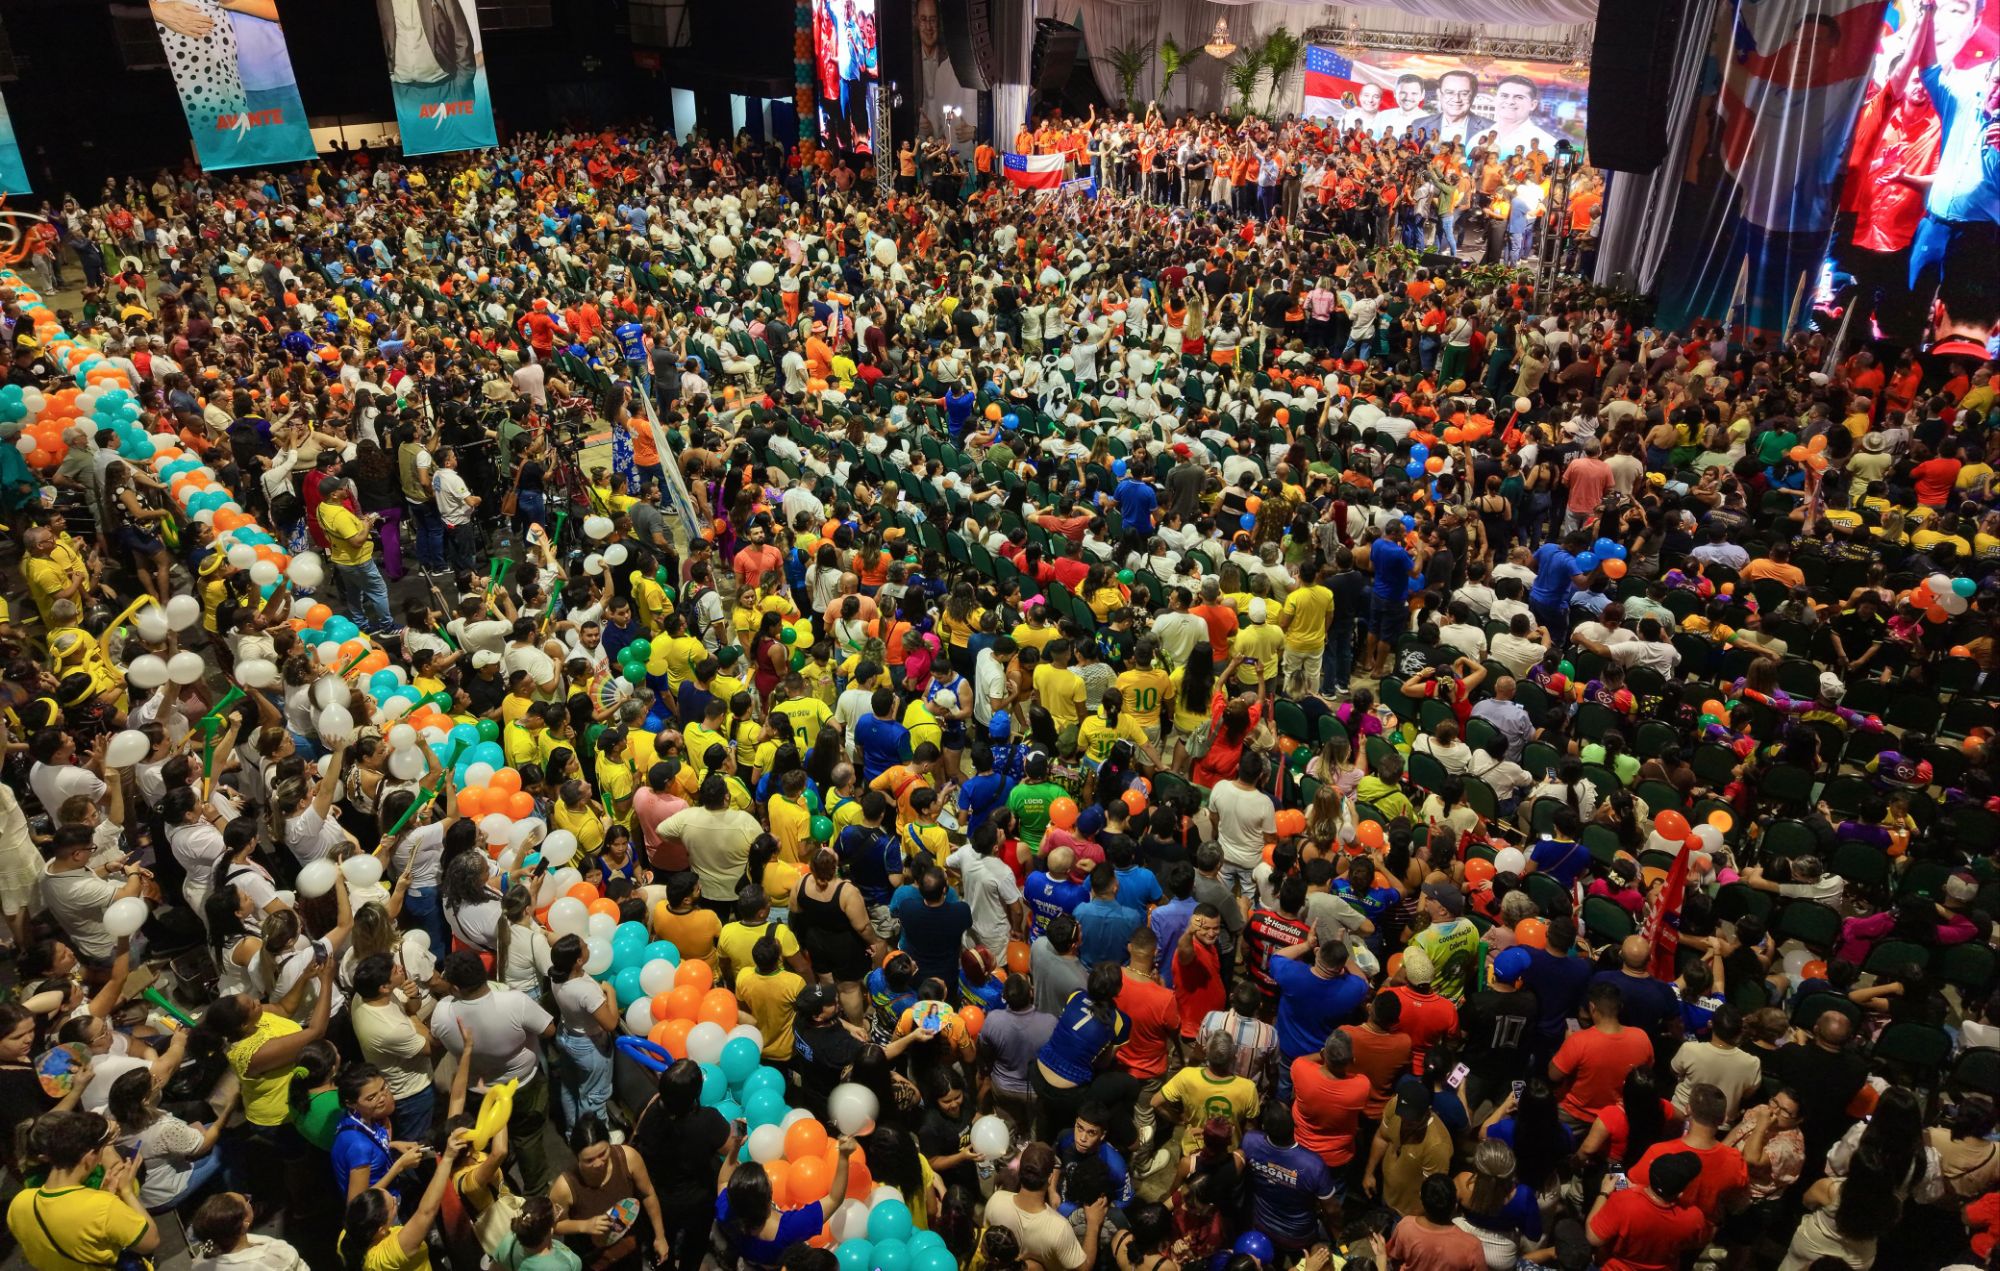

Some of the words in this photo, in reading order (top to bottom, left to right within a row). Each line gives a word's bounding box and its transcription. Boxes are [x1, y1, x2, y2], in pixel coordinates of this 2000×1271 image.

[1133, 687, 1157, 711] 10
[1271, 919, 1302, 937] Hapvida
[1072, 1007, 1094, 1031] 7
